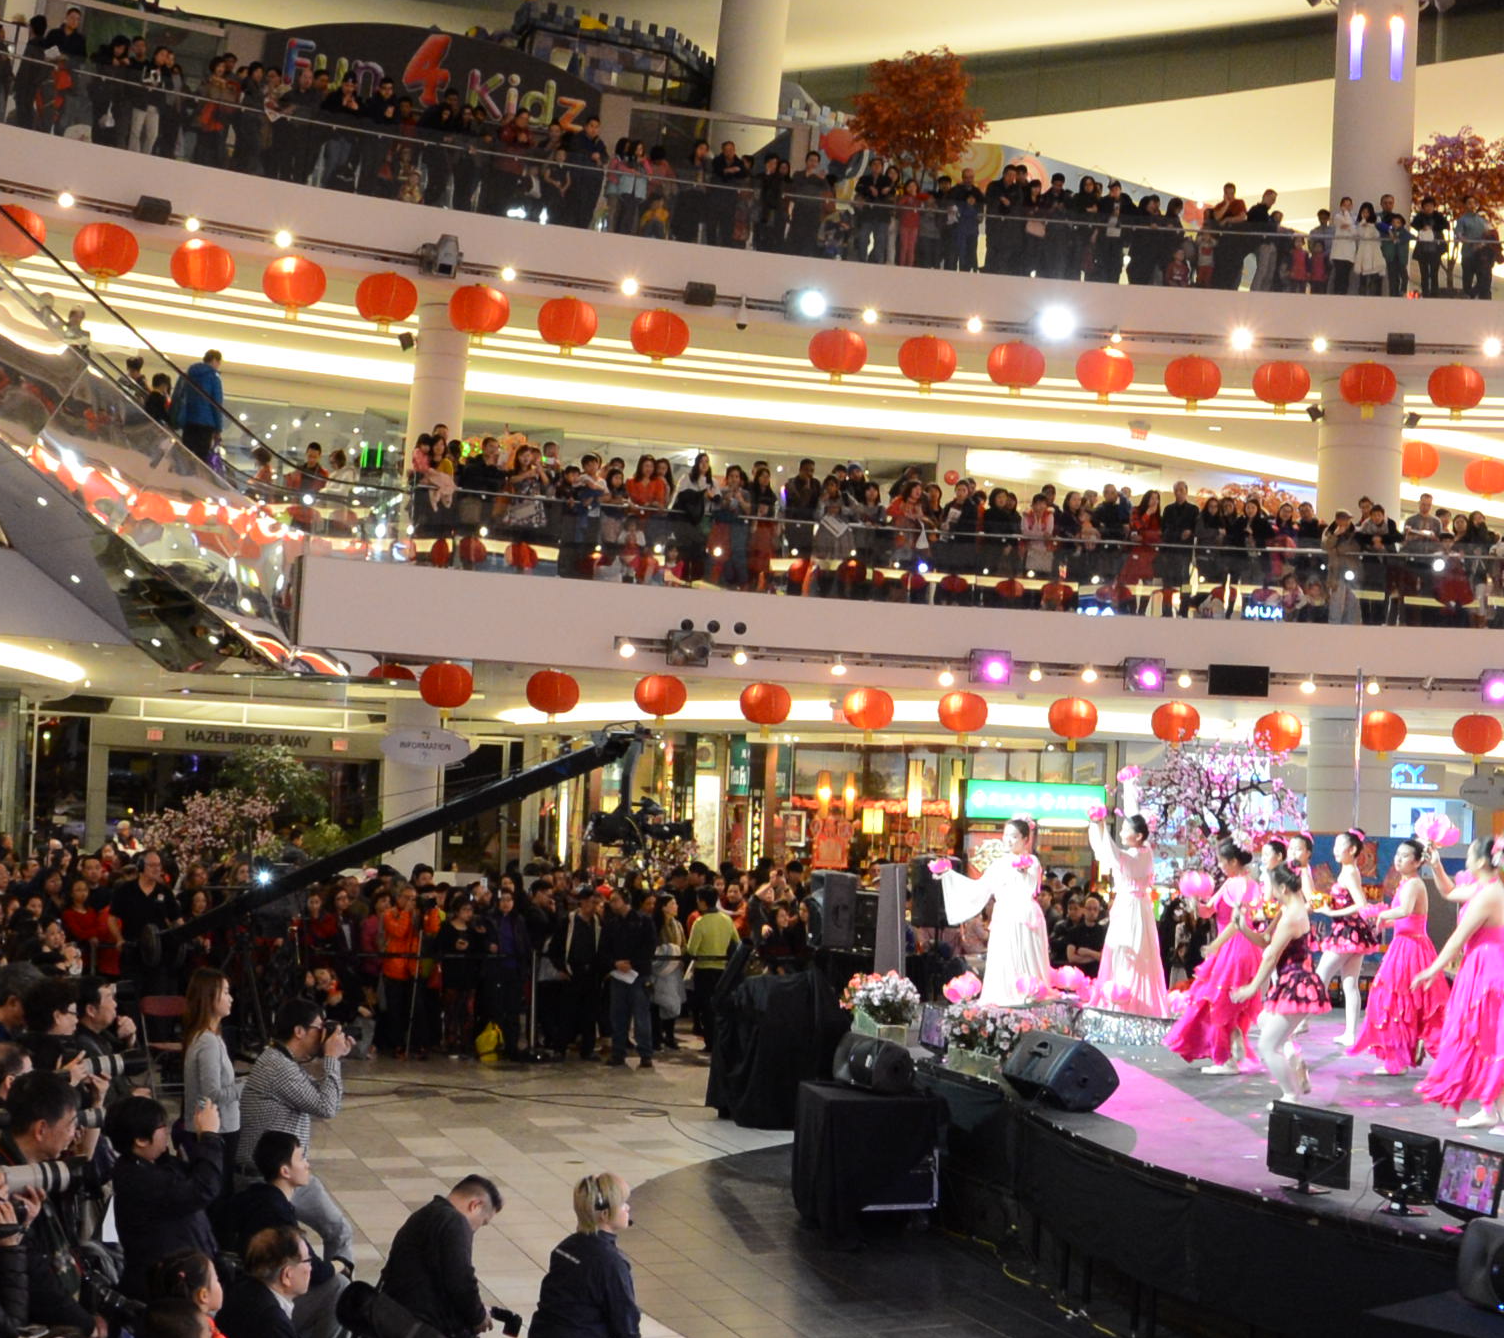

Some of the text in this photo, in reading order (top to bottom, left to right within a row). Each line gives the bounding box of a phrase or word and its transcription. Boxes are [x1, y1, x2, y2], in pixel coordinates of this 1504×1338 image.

[281, 34, 587, 132] Fun 4 Kidz
[184, 729, 312, 749] HAZELBRIDGE WAY
[399, 741, 451, 751] INFORMATION
